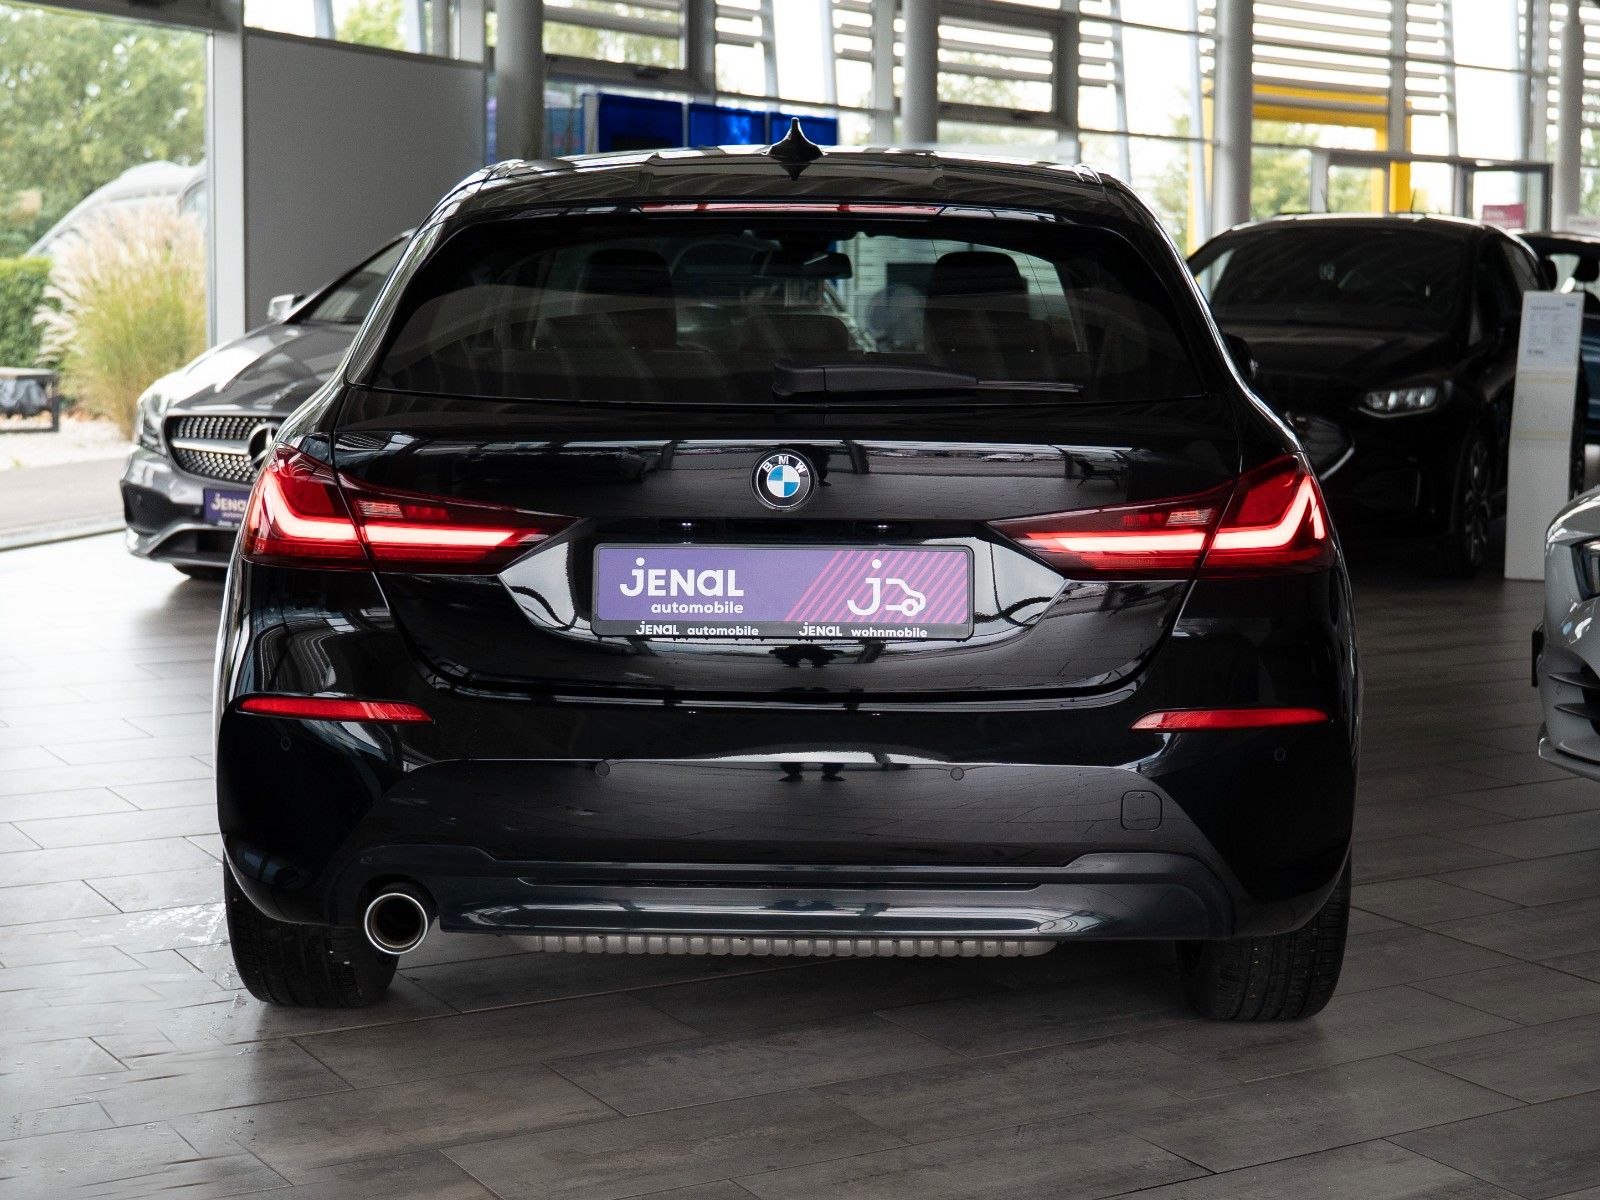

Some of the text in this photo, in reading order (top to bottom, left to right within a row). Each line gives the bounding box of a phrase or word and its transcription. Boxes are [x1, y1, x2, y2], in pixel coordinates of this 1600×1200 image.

[762, 455, 808, 474] BMW
[650, 601, 744, 614] automobile
[687, 625, 759, 636] automobile
[850, 626, 928, 638] wohnmobile
